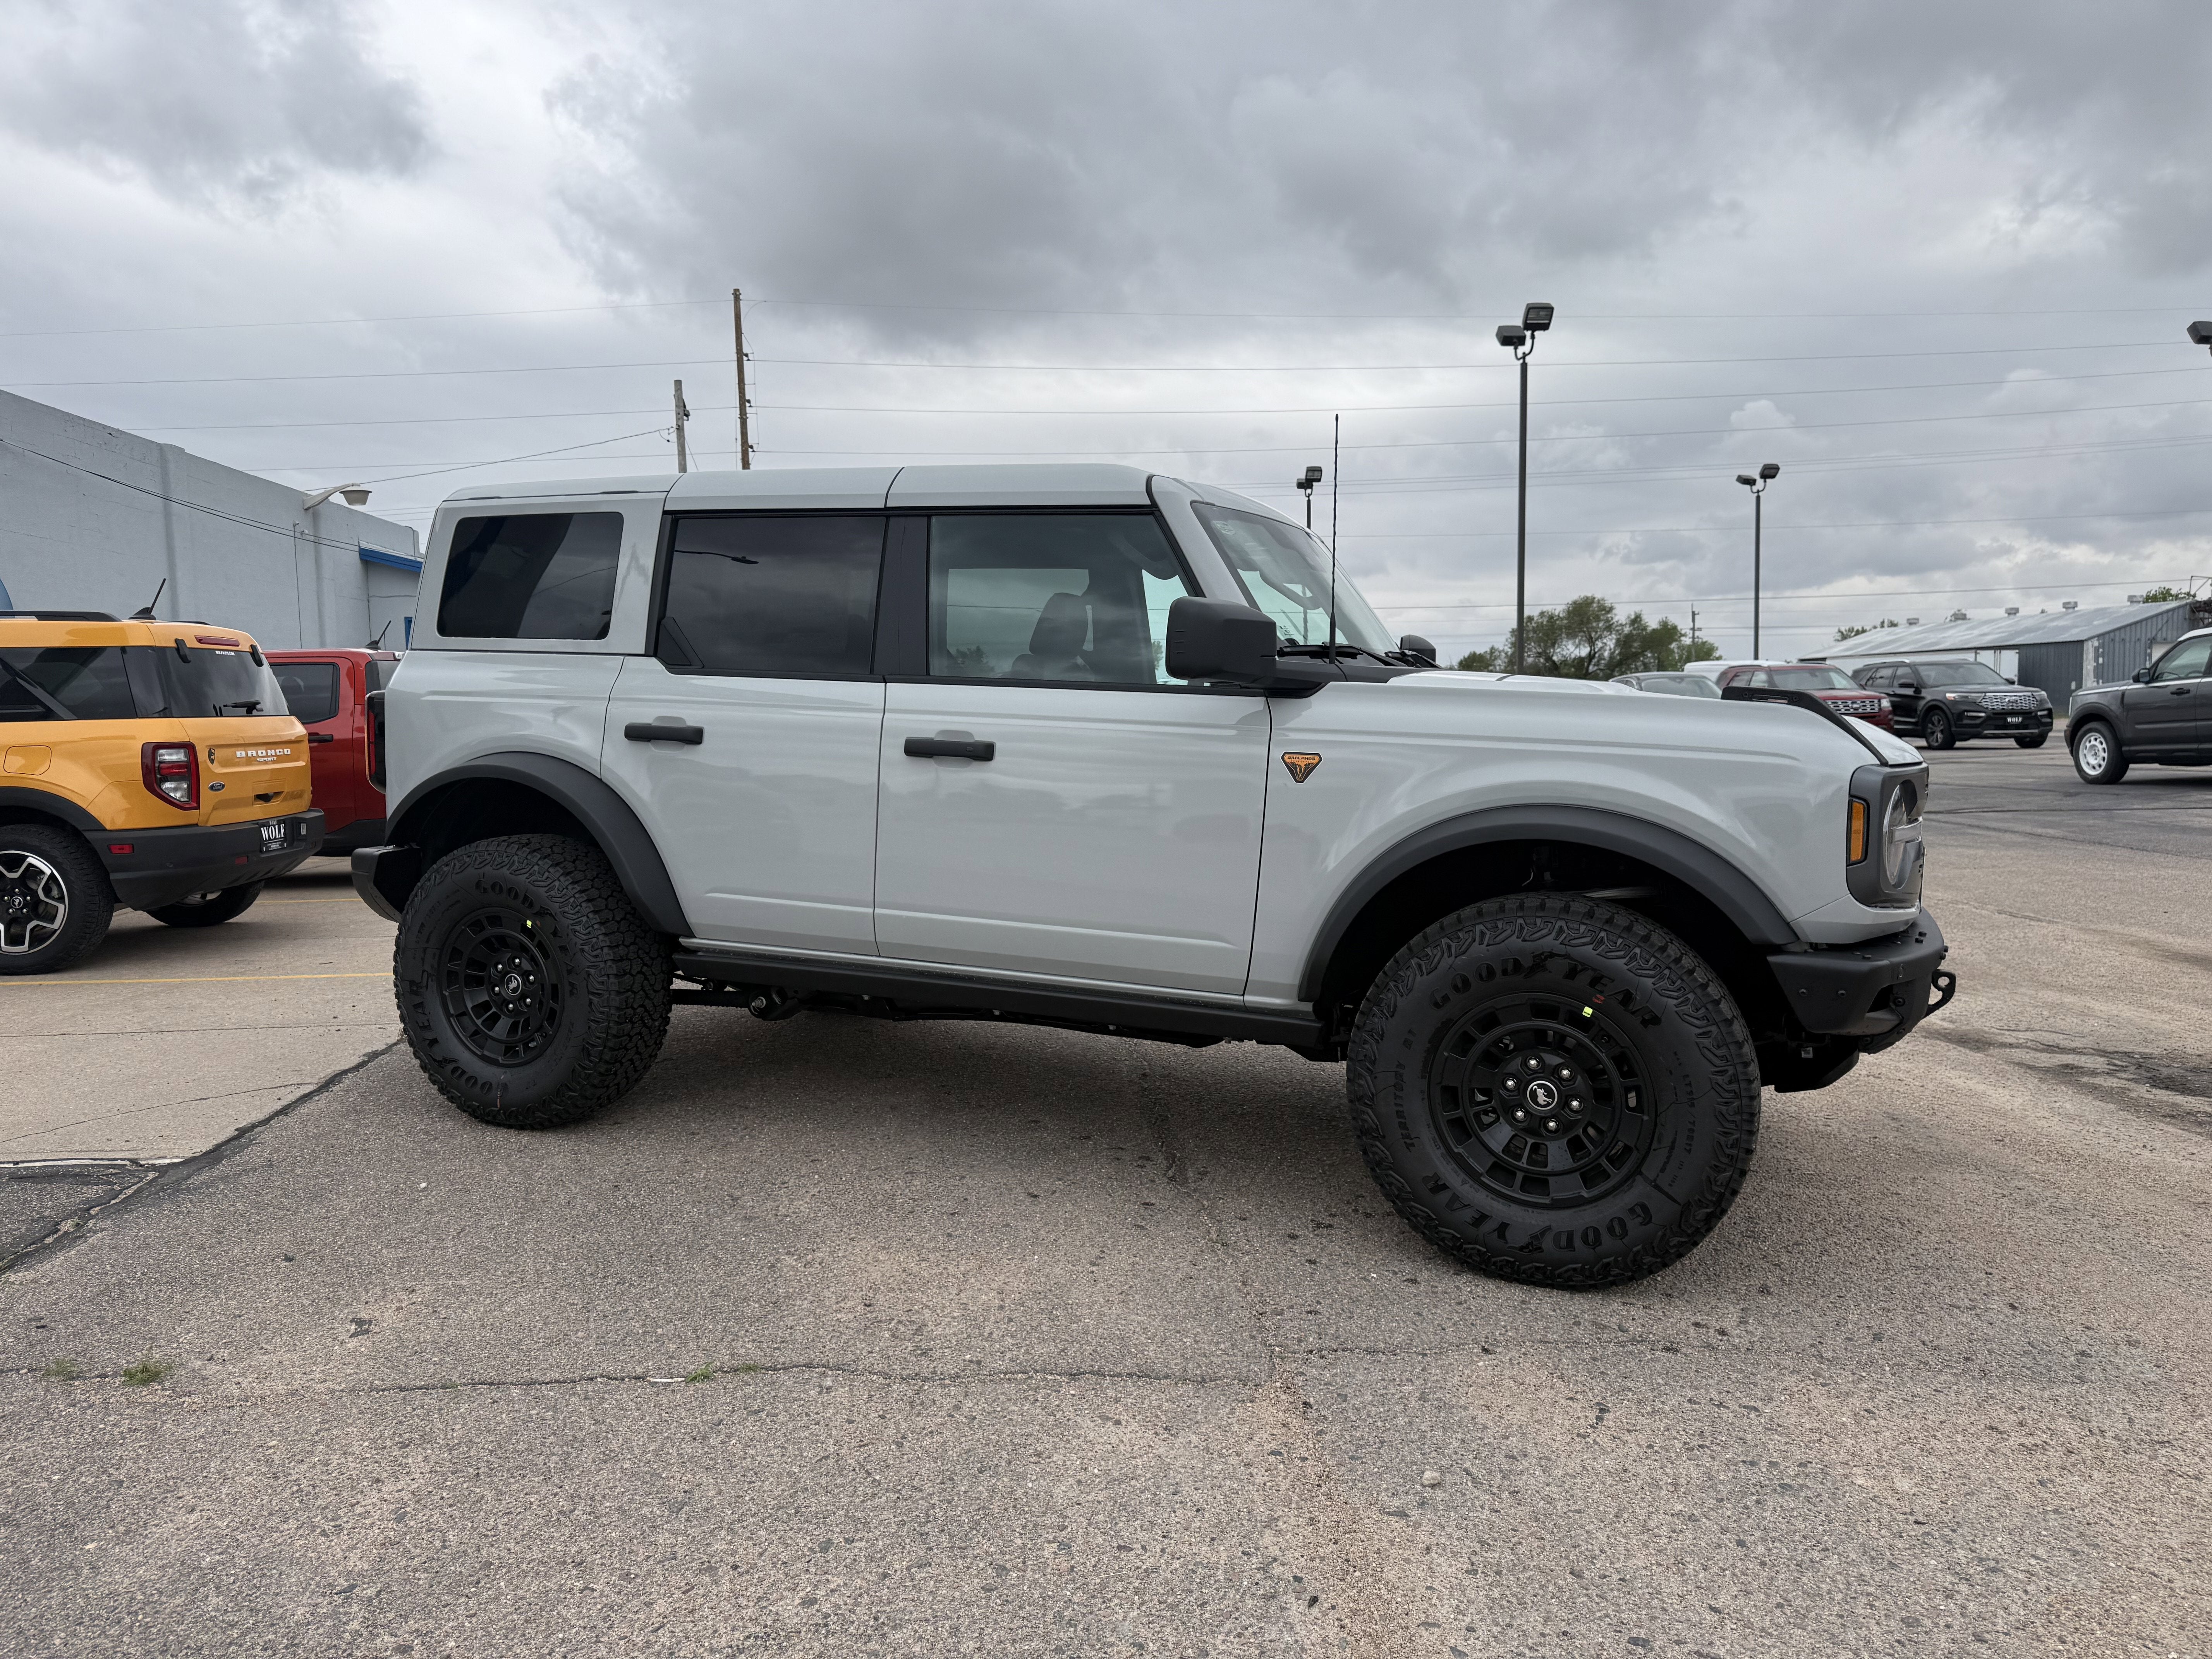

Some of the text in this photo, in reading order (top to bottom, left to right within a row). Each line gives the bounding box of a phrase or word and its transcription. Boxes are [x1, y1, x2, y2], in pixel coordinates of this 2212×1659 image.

[236, 749, 290, 757] BRONCO
[261, 824, 285, 840] WOLF
[1393, 1060, 1415, 1152] TERRITORY
